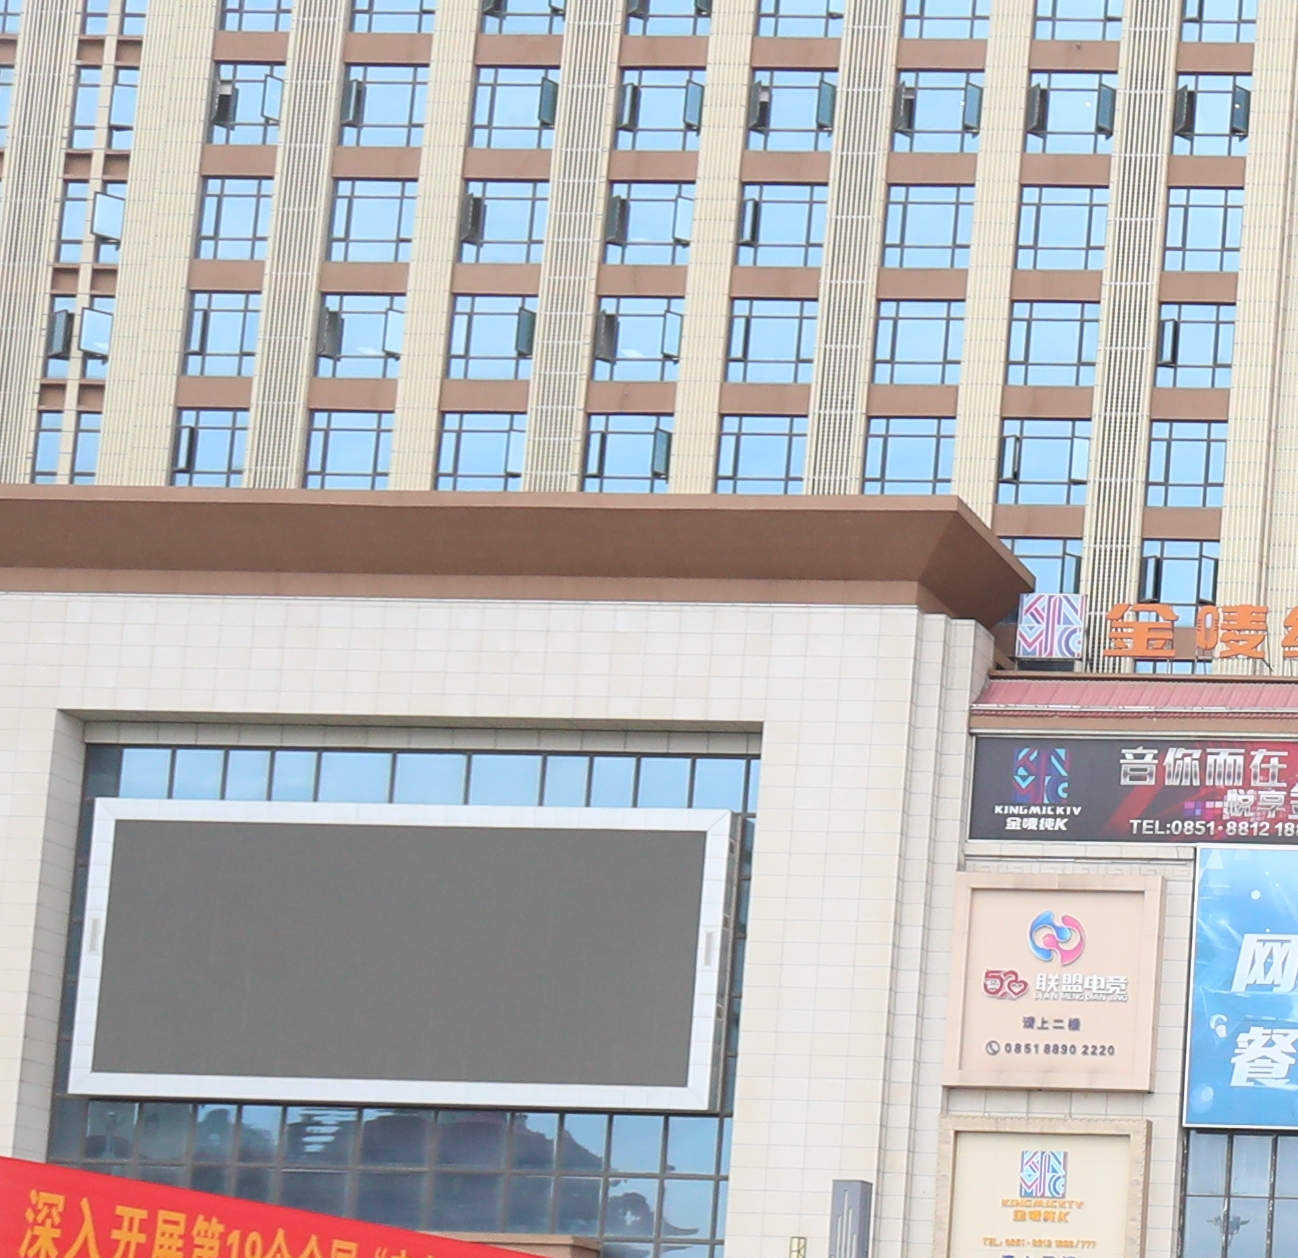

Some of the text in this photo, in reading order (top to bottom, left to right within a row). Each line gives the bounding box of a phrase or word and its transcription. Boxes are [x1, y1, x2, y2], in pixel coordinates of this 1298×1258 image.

[1119, 746, 1289, 788] 音你而在
[1004, 1043, 1040, 1055] 0851
[1081, 1044, 1116, 1056] 2220
